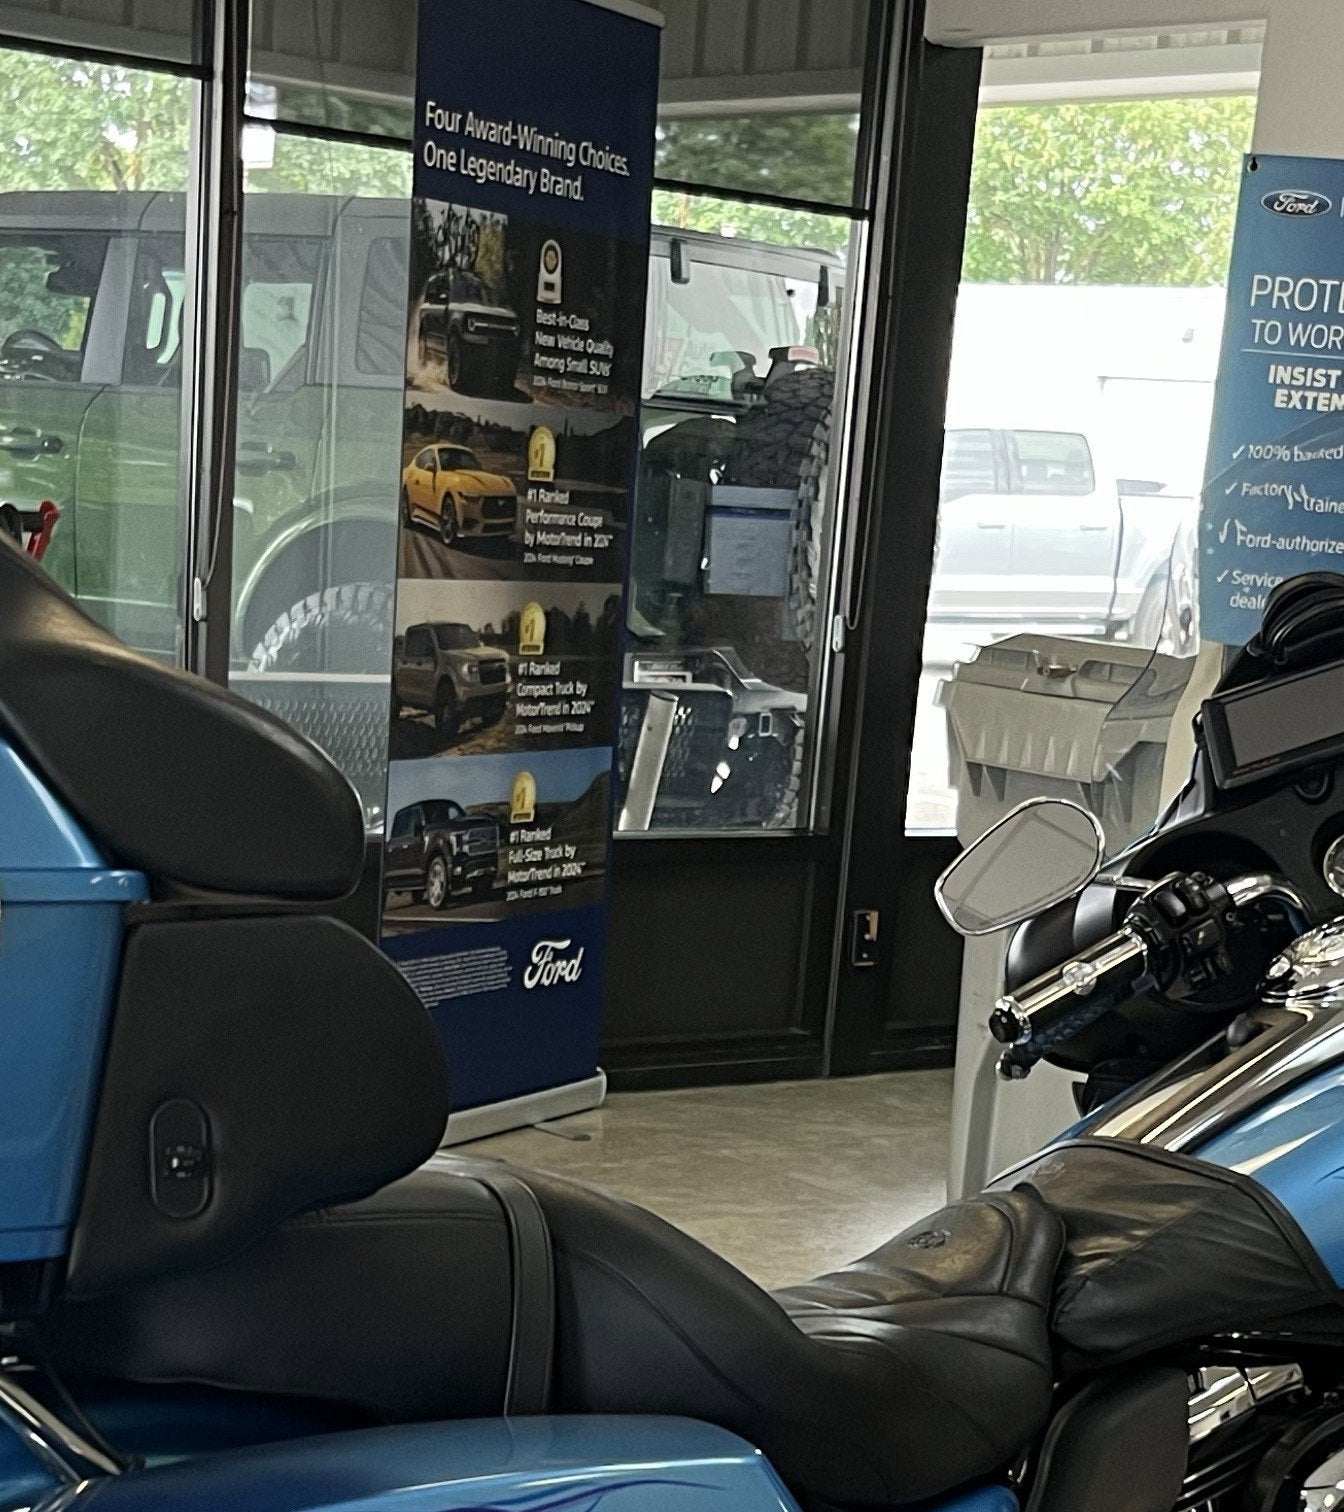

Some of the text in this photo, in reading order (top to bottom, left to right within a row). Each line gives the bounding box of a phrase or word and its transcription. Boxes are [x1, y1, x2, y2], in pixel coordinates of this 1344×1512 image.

[425, 100, 630, 177] Four Award-Winning Choices.
[423, 140, 584, 201] One Legendary Brand.
[1272, 191, 1320, 215] Ford
[1250, 318, 1283, 346] TO
[1268, 364, 1342, 388] INSIST
[1247, 444, 1291, 462] 100%
[1293, 443, 1344, 463] backed
[538, 487, 569, 505] Ranked
[525, 508, 603, 529] Performance Coupe
[529, 661, 561, 676] Ranked
[516, 682, 554, 698] Compact
[575, 680, 588, 698] by
[516, 701, 561, 717] MotorTrend
[520, 826, 552, 843] Ranked
[564, 843, 577, 860] by
[507, 866, 553, 883] MotorTrend
[524, 938, 585, 989] Ford
